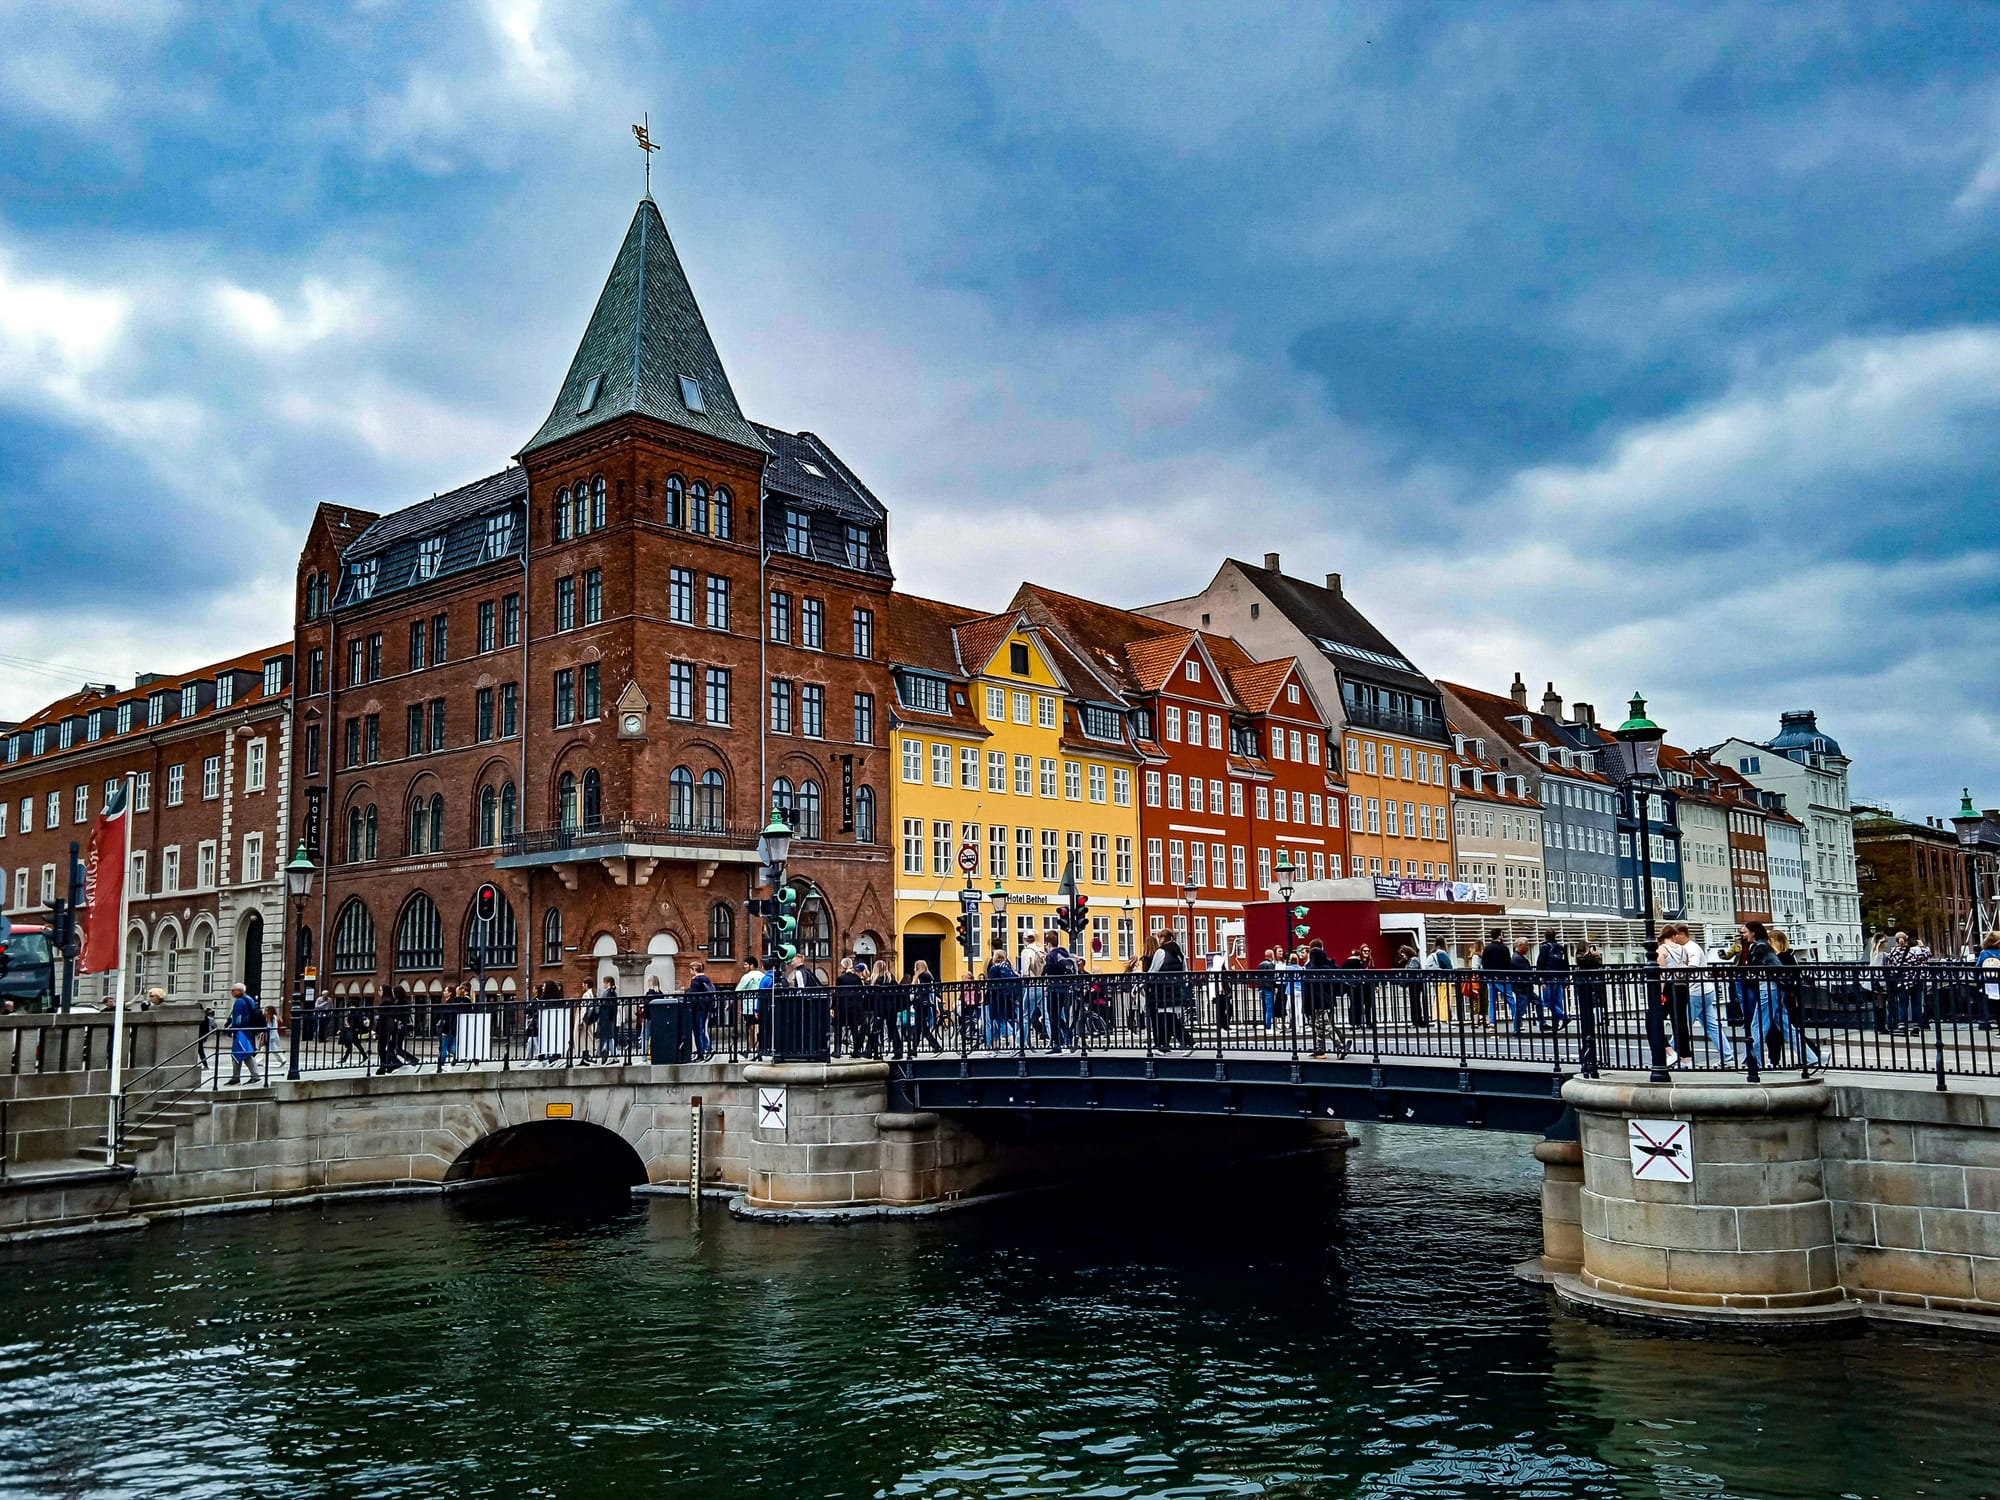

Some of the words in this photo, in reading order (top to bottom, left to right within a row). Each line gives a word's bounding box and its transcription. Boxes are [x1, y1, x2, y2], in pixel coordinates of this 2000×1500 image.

[311, 796, 319, 844] HOTEL
[1006, 894, 1025, 903] Hotel
[1026, 894, 1048, 905] Bethel
